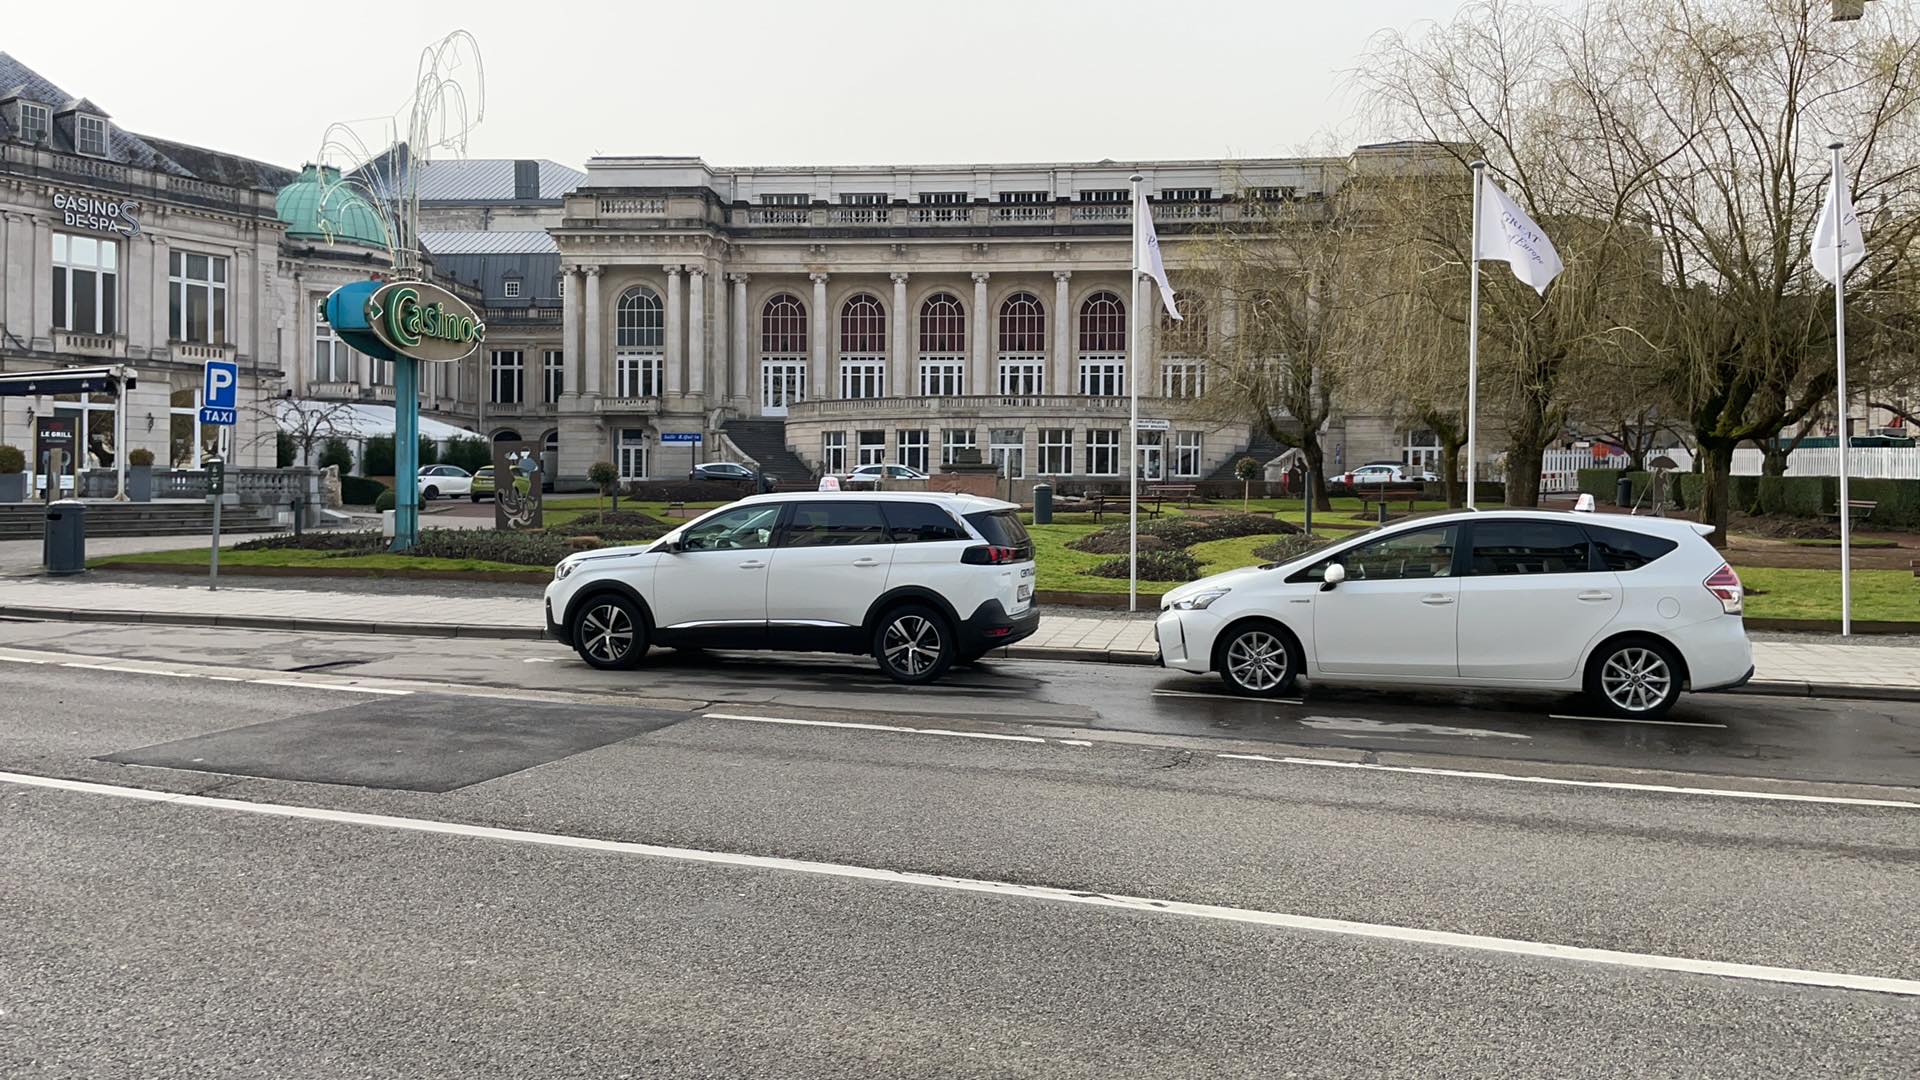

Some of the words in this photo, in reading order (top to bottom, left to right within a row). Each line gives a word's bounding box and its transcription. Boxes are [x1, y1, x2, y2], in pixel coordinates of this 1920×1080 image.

[53, 193, 119, 218] CASINO
[64, 212, 85, 227] DE
[88, 216, 118, 232] SPA
[386, 287, 475, 347] Casino
[209, 368, 233, 401] P
[205, 410, 233, 423] TAXI
